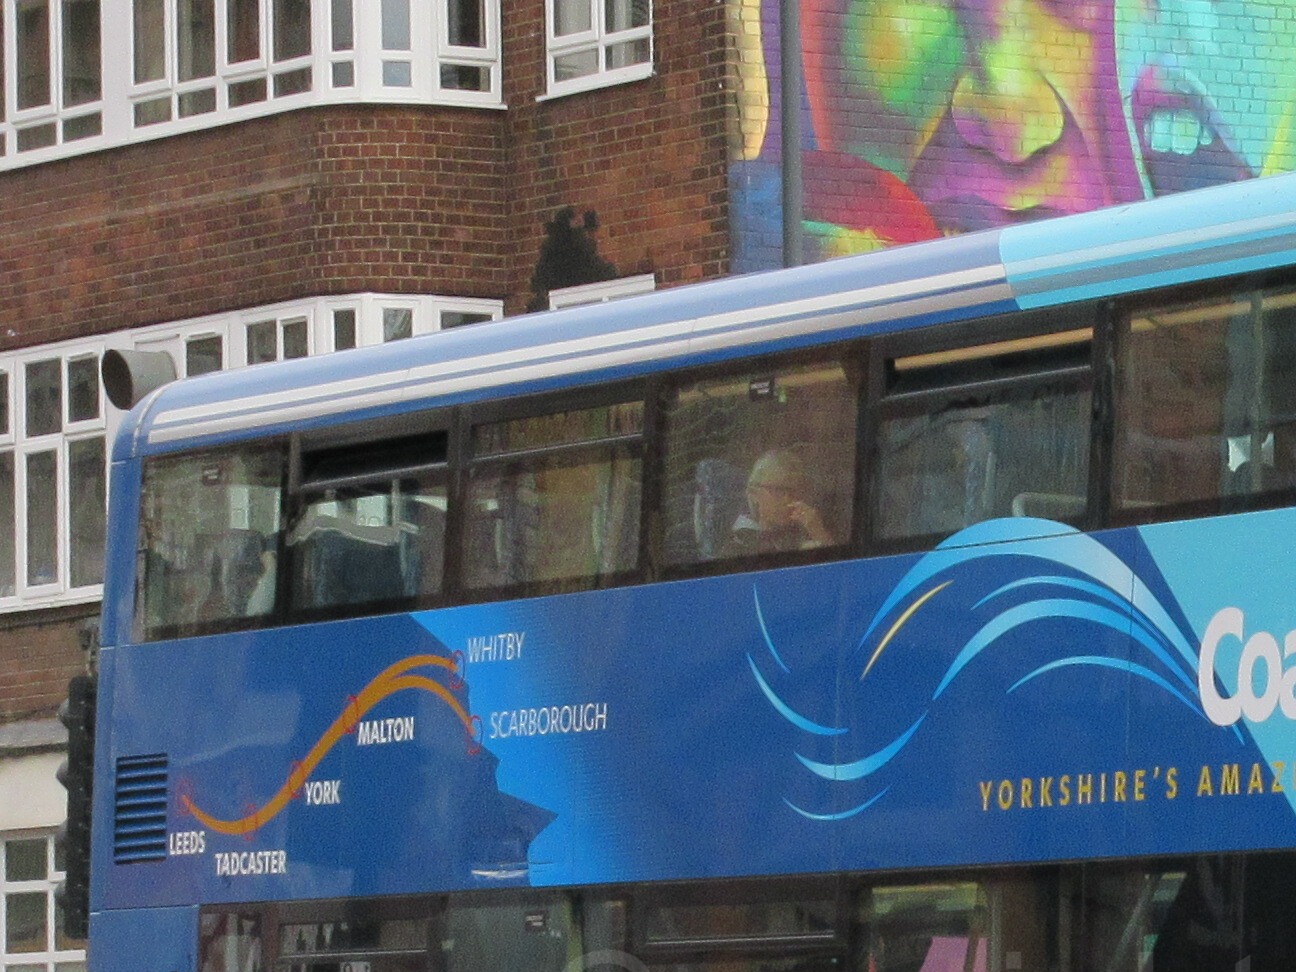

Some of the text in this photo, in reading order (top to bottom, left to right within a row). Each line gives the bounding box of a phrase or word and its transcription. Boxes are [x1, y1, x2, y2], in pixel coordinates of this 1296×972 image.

[467, 631, 526, 663] WHITBY
[357, 716, 415, 745] MALTON
[489, 702, 608, 739] SCARBOROUGH
[305, 780, 341, 805] YORK
[979, 765, 1178, 812] YORKSHIRE'S
[169, 831, 206, 855] LEEDS
[215, 850, 287, 876] TADCASTER
